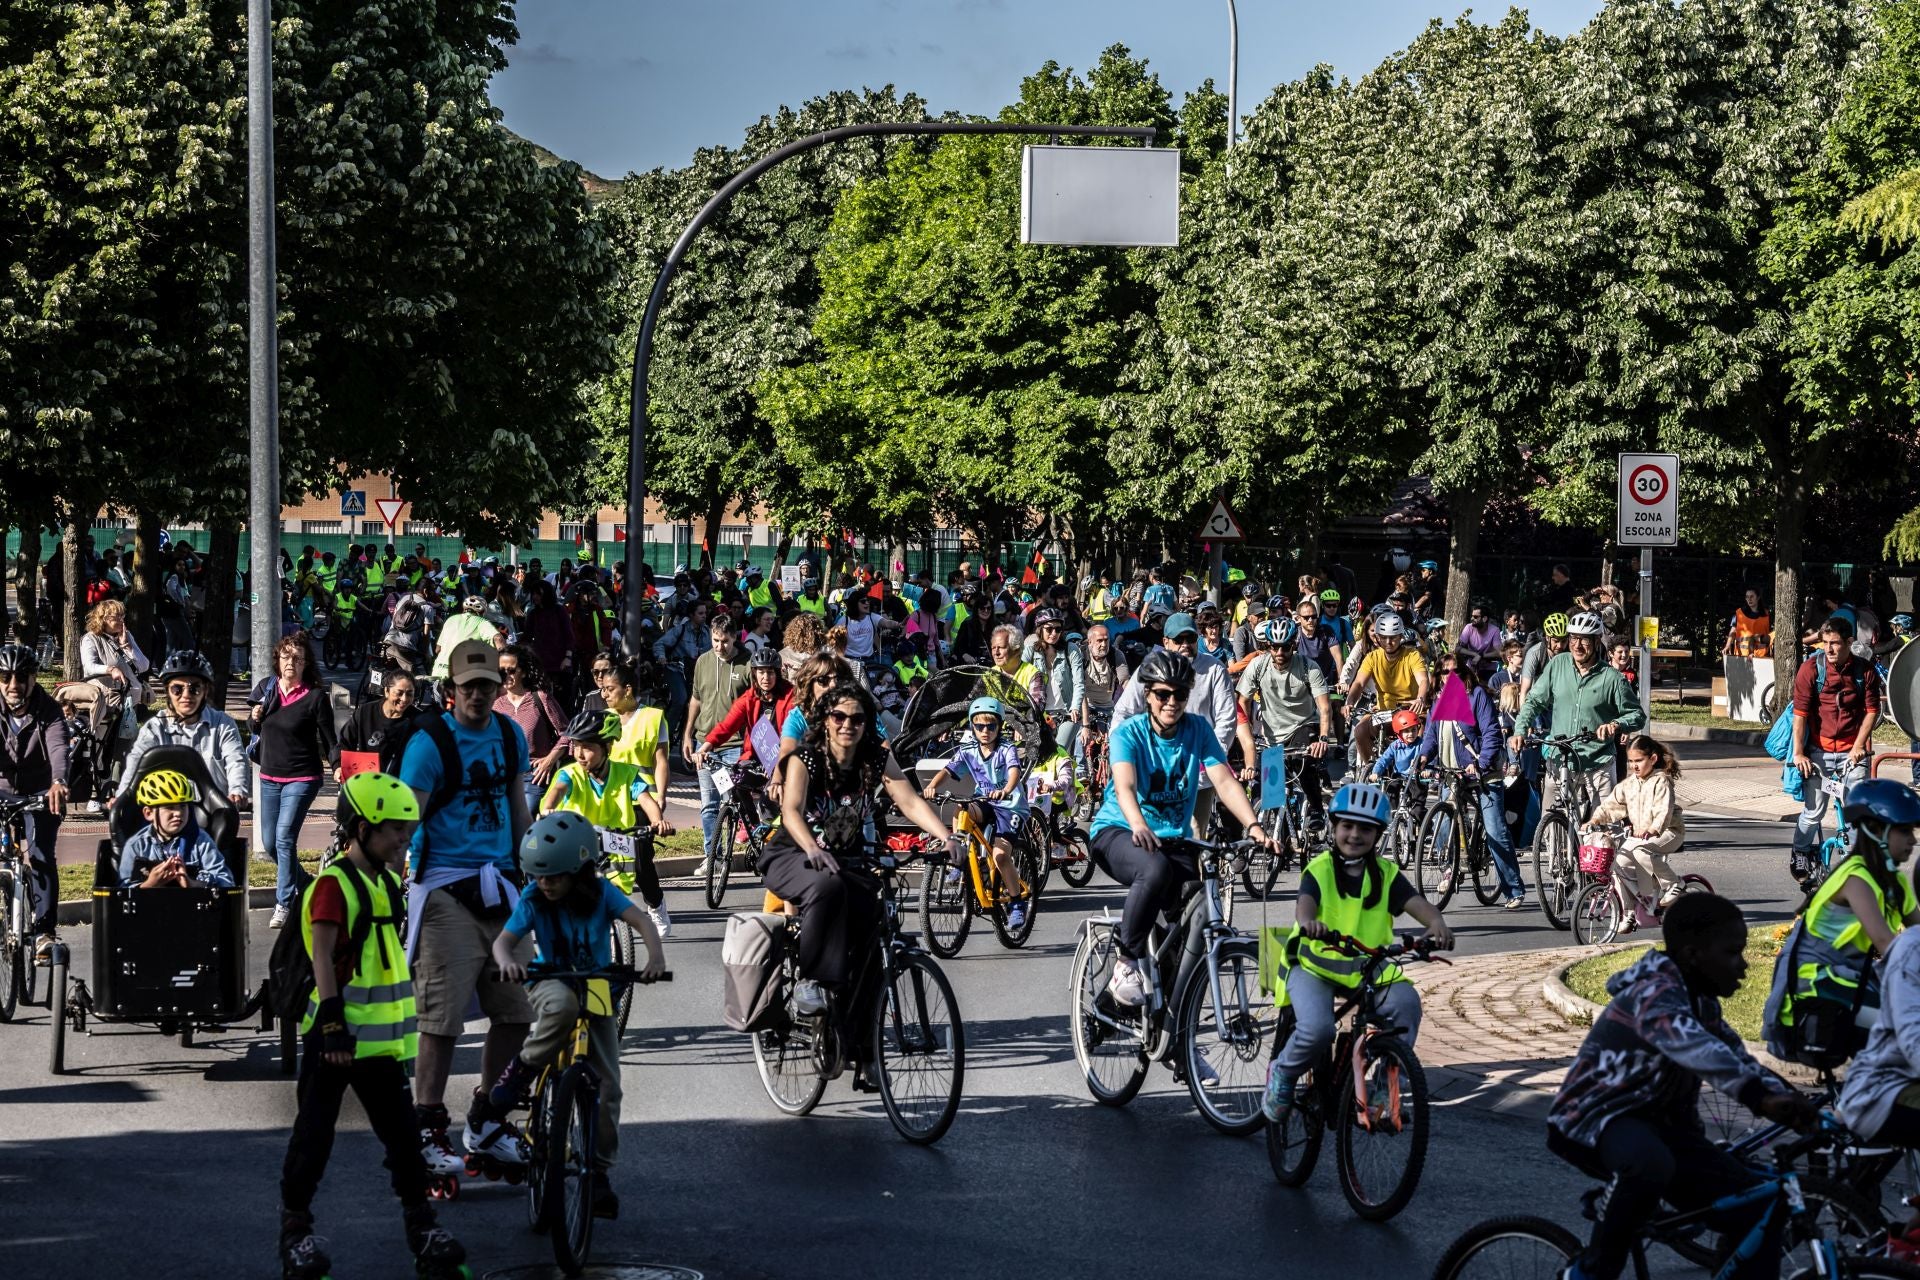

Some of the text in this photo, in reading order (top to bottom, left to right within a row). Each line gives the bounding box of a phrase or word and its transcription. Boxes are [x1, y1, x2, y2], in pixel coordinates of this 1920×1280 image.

[1637, 477, 1660, 492] 30
[1634, 512, 1662, 522] ZONA
[1625, 526, 1671, 537] ESCOLAR
[1010, 813, 1020, 829] 8
